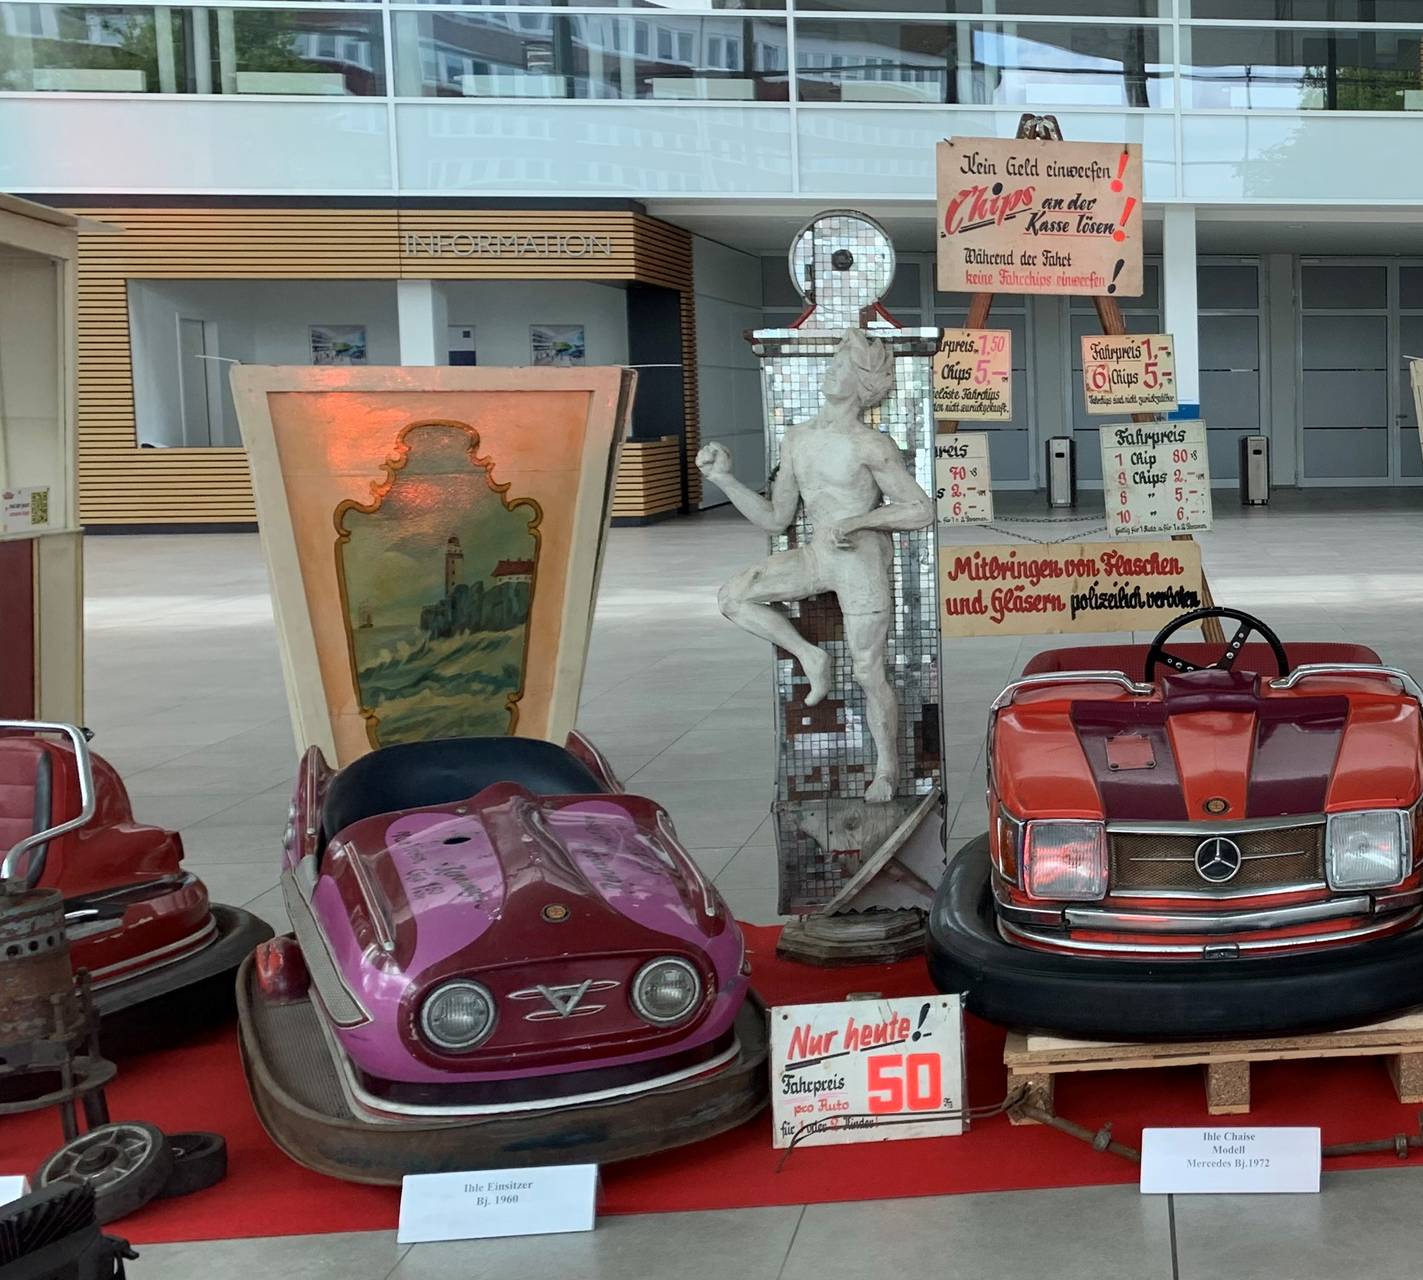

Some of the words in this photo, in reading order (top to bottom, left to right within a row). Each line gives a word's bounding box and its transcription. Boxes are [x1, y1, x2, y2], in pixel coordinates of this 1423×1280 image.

[960, 152, 997, 175] Kein
[1006, 156, 1039, 177] Geld
[944, 182, 1036, 235] Chips
[1041, 197, 1064, 211] an
[1066, 193, 1097, 211] der
[1025, 211, 1070, 236] Kasse
[405, 233, 613, 257] INFORMATION
[963, 247, 1014, 266] Während
[1020, 249, 1038, 267] der
[1042, 249, 1072, 267] Fahrt
[965, 270, 993, 285] keine
[999, 270, 1051, 288] Fahrchips
[1089, 339, 1142, 364] Fahrpreis
[941, 361, 973, 386] Chips
[1092, 364, 1106, 389] 6
[1111, 368, 1139, 388] Chips
[961, 388, 1000, 403] Fahrchips
[1114, 424, 1186, 450] Fahrpreis
[1114, 453, 1122, 466] 1
[1130, 450, 1157, 469] Chip
[1173, 449, 1188, 463] 80
[949, 466, 966, 480] 70
[1132, 470, 1168, 488] Chips
[1116, 509, 1131, 524] 10
[948, 551, 1063, 587] Mitbringen
[1063, 557, 1100, 577] von
[1100, 550, 1184, 577] Flaschen
[946, 589, 988, 616] und
[989, 585, 1066, 624] Gläsern
[1070, 581, 1147, 620] polizeilich
[1146, 585, 1202, 608] verboten
[787, 1023, 838, 1060] Nur
[781, 1073, 845, 1098] Fahrpreis
[866, 1052, 943, 1114] 50
[793, 1102, 814, 1116] pro
[817, 1099, 850, 1113] Auto
[780, 1120, 796, 1138] für
[1203, 1132, 1221, 1141] Ihle
[1224, 1131, 1256, 1141] Chaise
[1212, 1145, 1246, 1154] Modell
[1186, 1158, 1232, 1168] Mercedes
[1235, 1158, 1271, 1170] Bj.1972
[464, 1183, 485, 1193] Ihle
[487, 1181, 534, 1192] Einsitzer
[476, 1197, 491, 1208] Bj.
[495, 1195, 519, 1205] 1960
